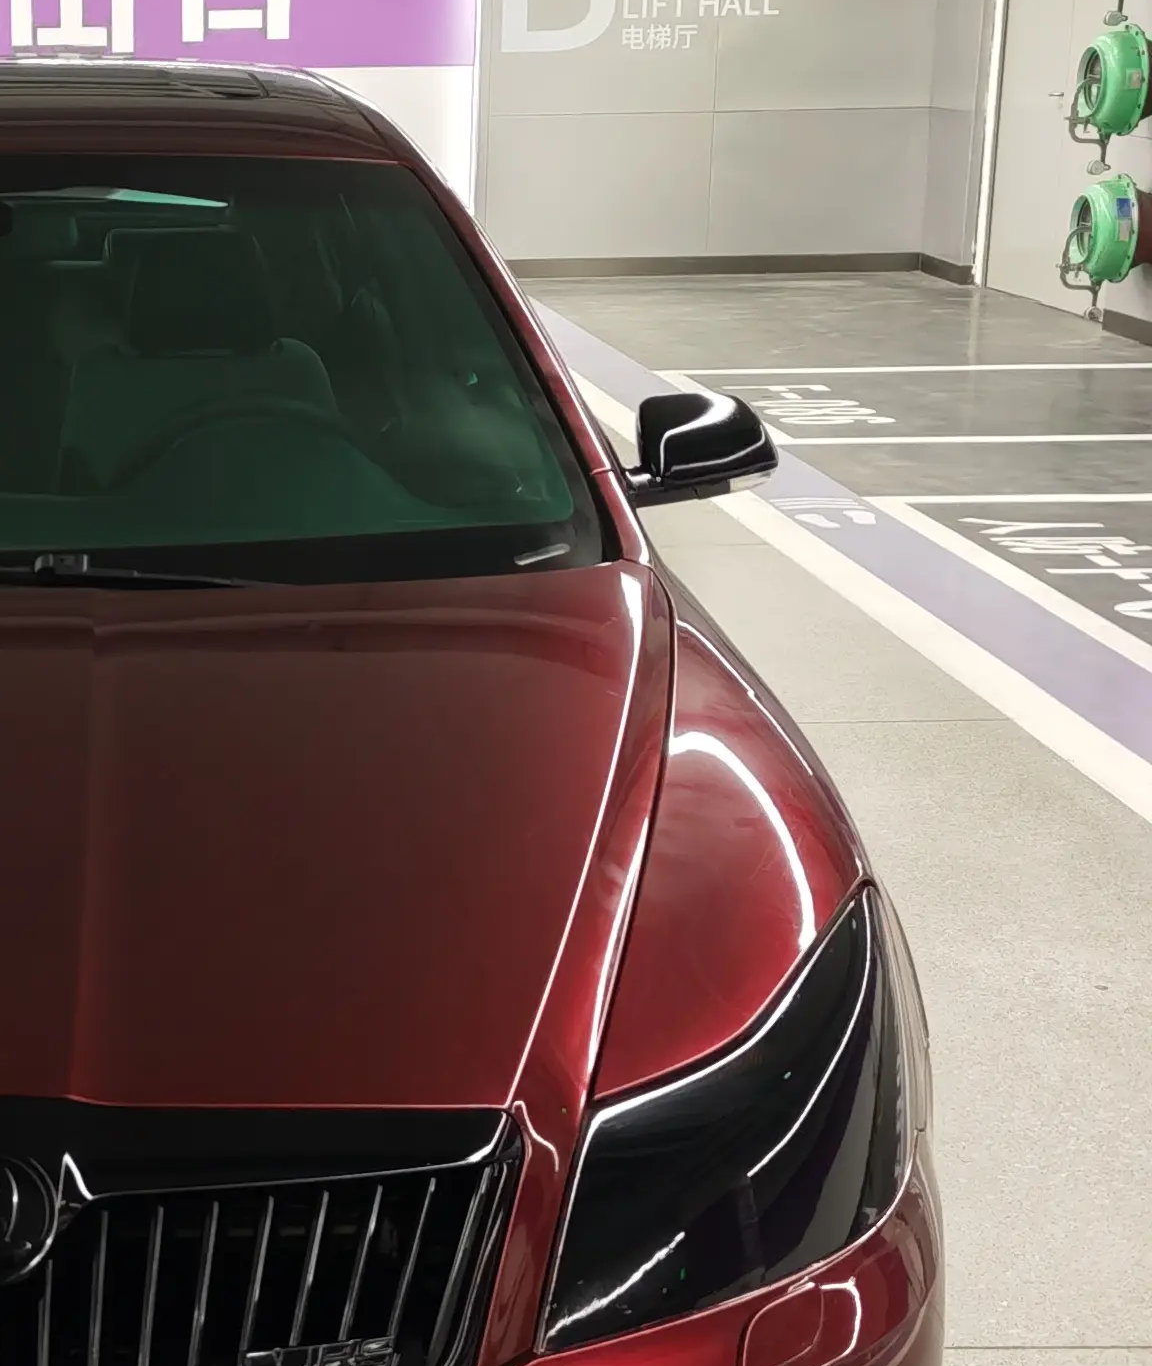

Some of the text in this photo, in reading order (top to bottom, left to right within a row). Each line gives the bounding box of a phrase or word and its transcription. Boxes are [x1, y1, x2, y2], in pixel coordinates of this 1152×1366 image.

[621, 24, 699, 51] 电梯厅
[721, 383, 897, 426] F-086
